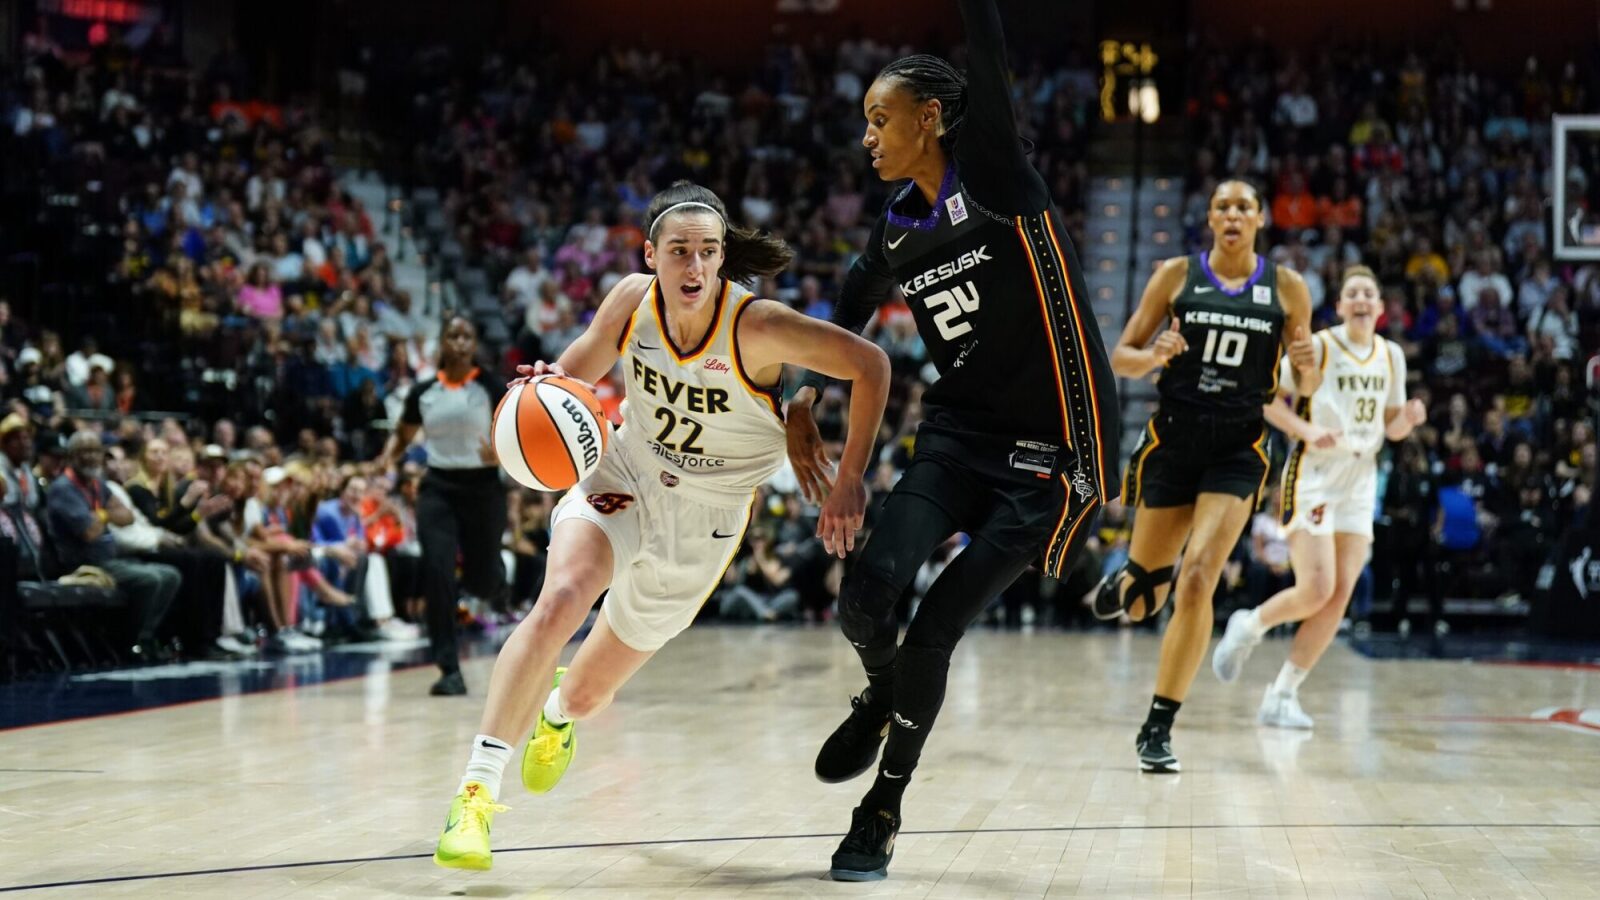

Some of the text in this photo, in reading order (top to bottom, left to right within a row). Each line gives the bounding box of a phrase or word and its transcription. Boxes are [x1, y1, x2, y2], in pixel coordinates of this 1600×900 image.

[899, 245, 993, 298] KEESUSK
[1184, 311, 1273, 335] KEESUSK
[704, 358, 730, 374] Lilly
[1201, 328, 1249, 367] 10
[632, 355, 731, 414] FEVER
[1356, 398, 1376, 422] 33
[561, 397, 599, 471] Wilson
[655, 407, 704, 454] 22
[646, 440, 725, 469] alesforce
